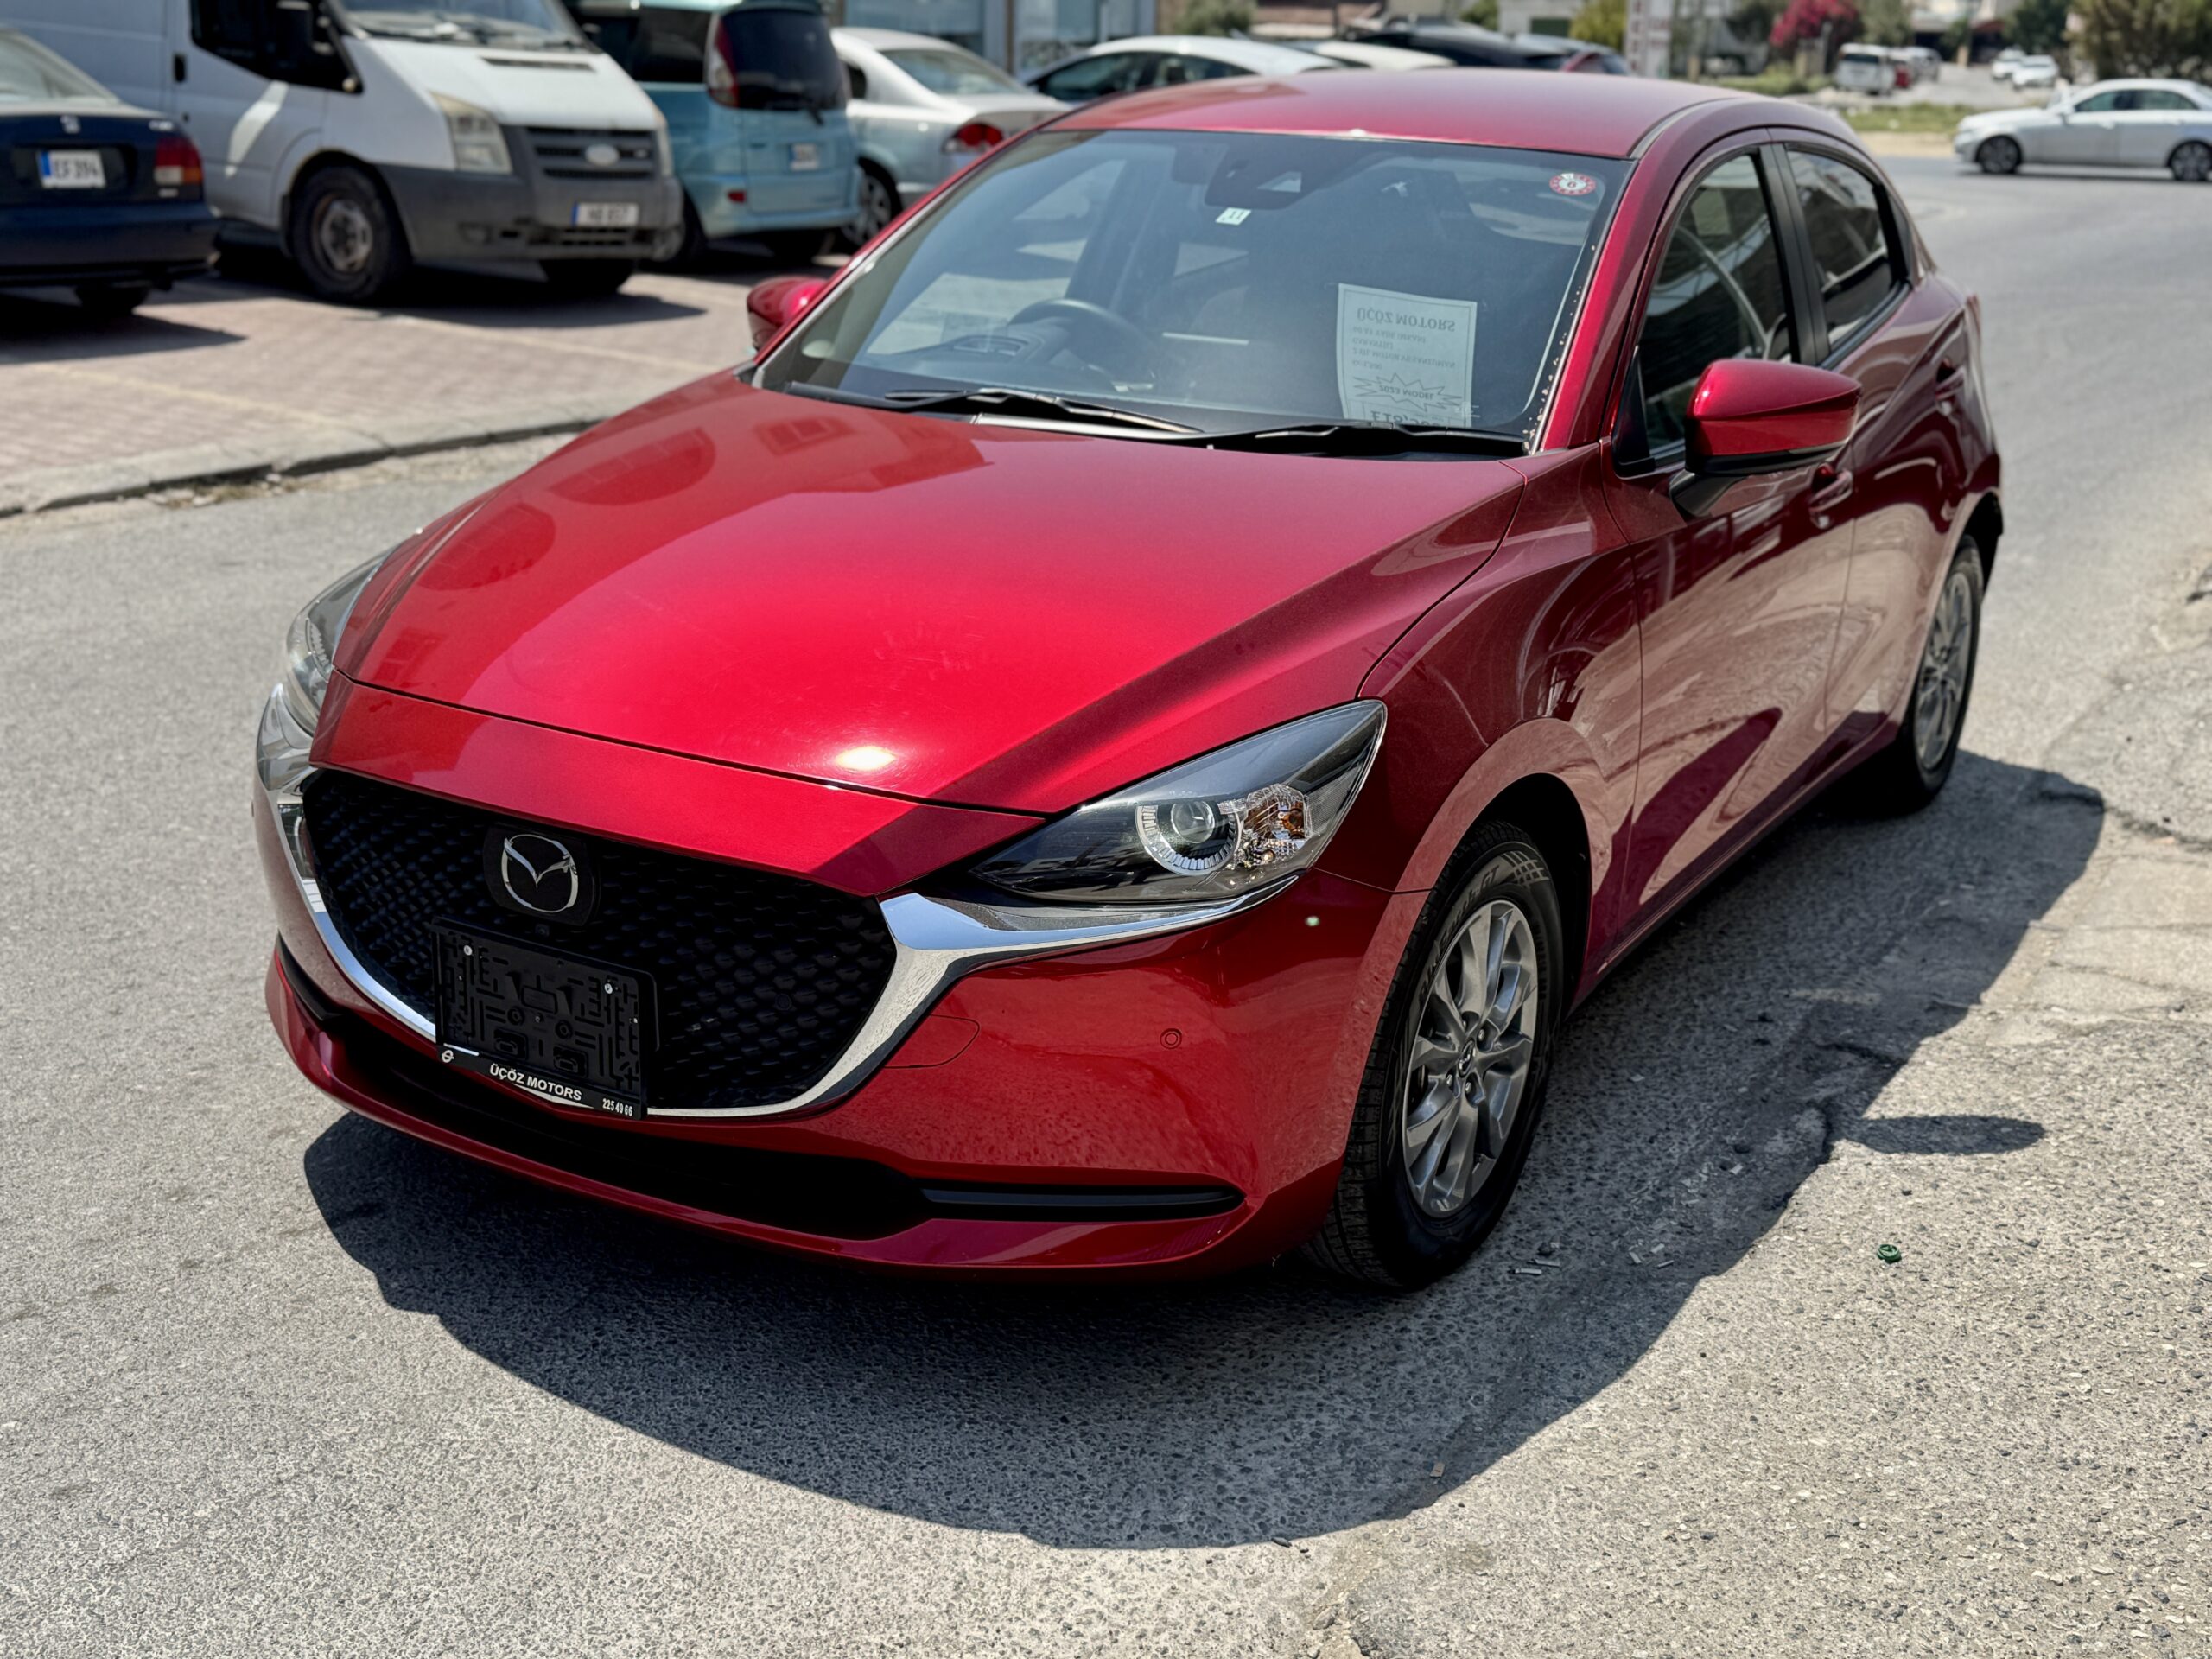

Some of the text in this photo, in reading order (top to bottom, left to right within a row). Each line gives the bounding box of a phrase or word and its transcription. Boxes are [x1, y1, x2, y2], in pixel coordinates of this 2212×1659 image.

[489, 1063, 524, 1084] ÜÇÖZ
[527, 1076, 582, 1101] MOTORS
[602, 1098, 614, 1111] 225
[615, 1101, 624, 1114] 49
